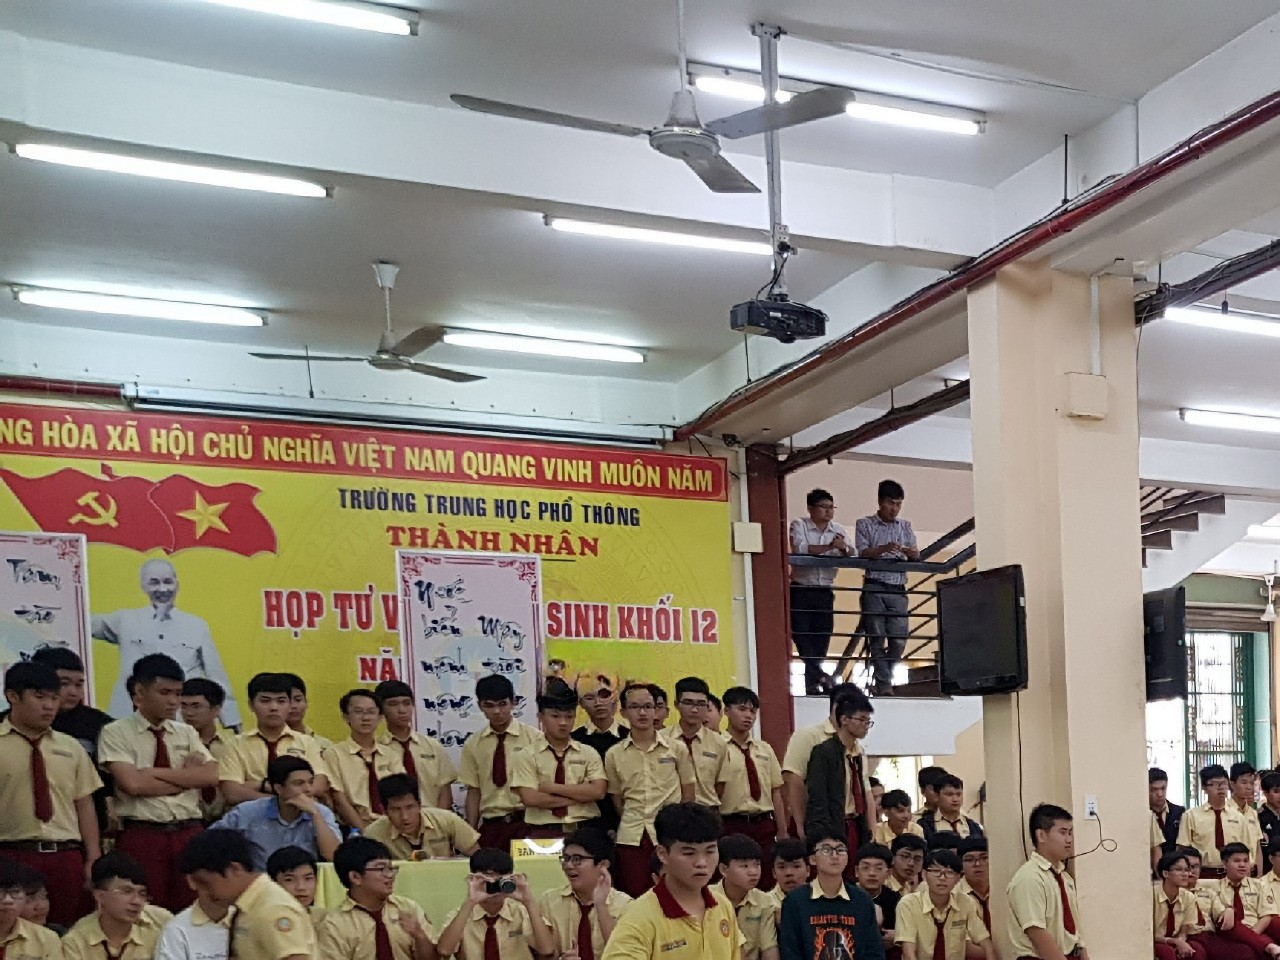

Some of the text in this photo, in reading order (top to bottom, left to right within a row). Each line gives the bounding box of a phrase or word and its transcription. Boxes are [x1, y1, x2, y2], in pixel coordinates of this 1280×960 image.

[42, 414, 98, 449] HÒA
[107, 420, 141, 452] XÃ
[150, 423, 195, 460] HỘI
[203, 425, 253, 460] CHỦ
[263, 433, 336, 465] NGHĨA
[342, 437, 396, 473] VIỆT
[404, 446, 455, 474] NAM
[462, 450, 536, 480] QUANG
[541, 457, 592, 483] VINH
[600, 458, 661, 488] MUÔN
[668, 464, 712, 492] NĂM
[338, 486, 640, 527] TRƯỜNG TRUNG HỌC PHỔ THÔNG
[385, 522, 600, 557] THÀNH NHÂN
[264, 589, 325, 638] HỌP
[332, 584, 376, 630] TƯ
[547, 594, 719, 643] SINH KHỐI 12
[359, 648, 400, 682] NĂ
